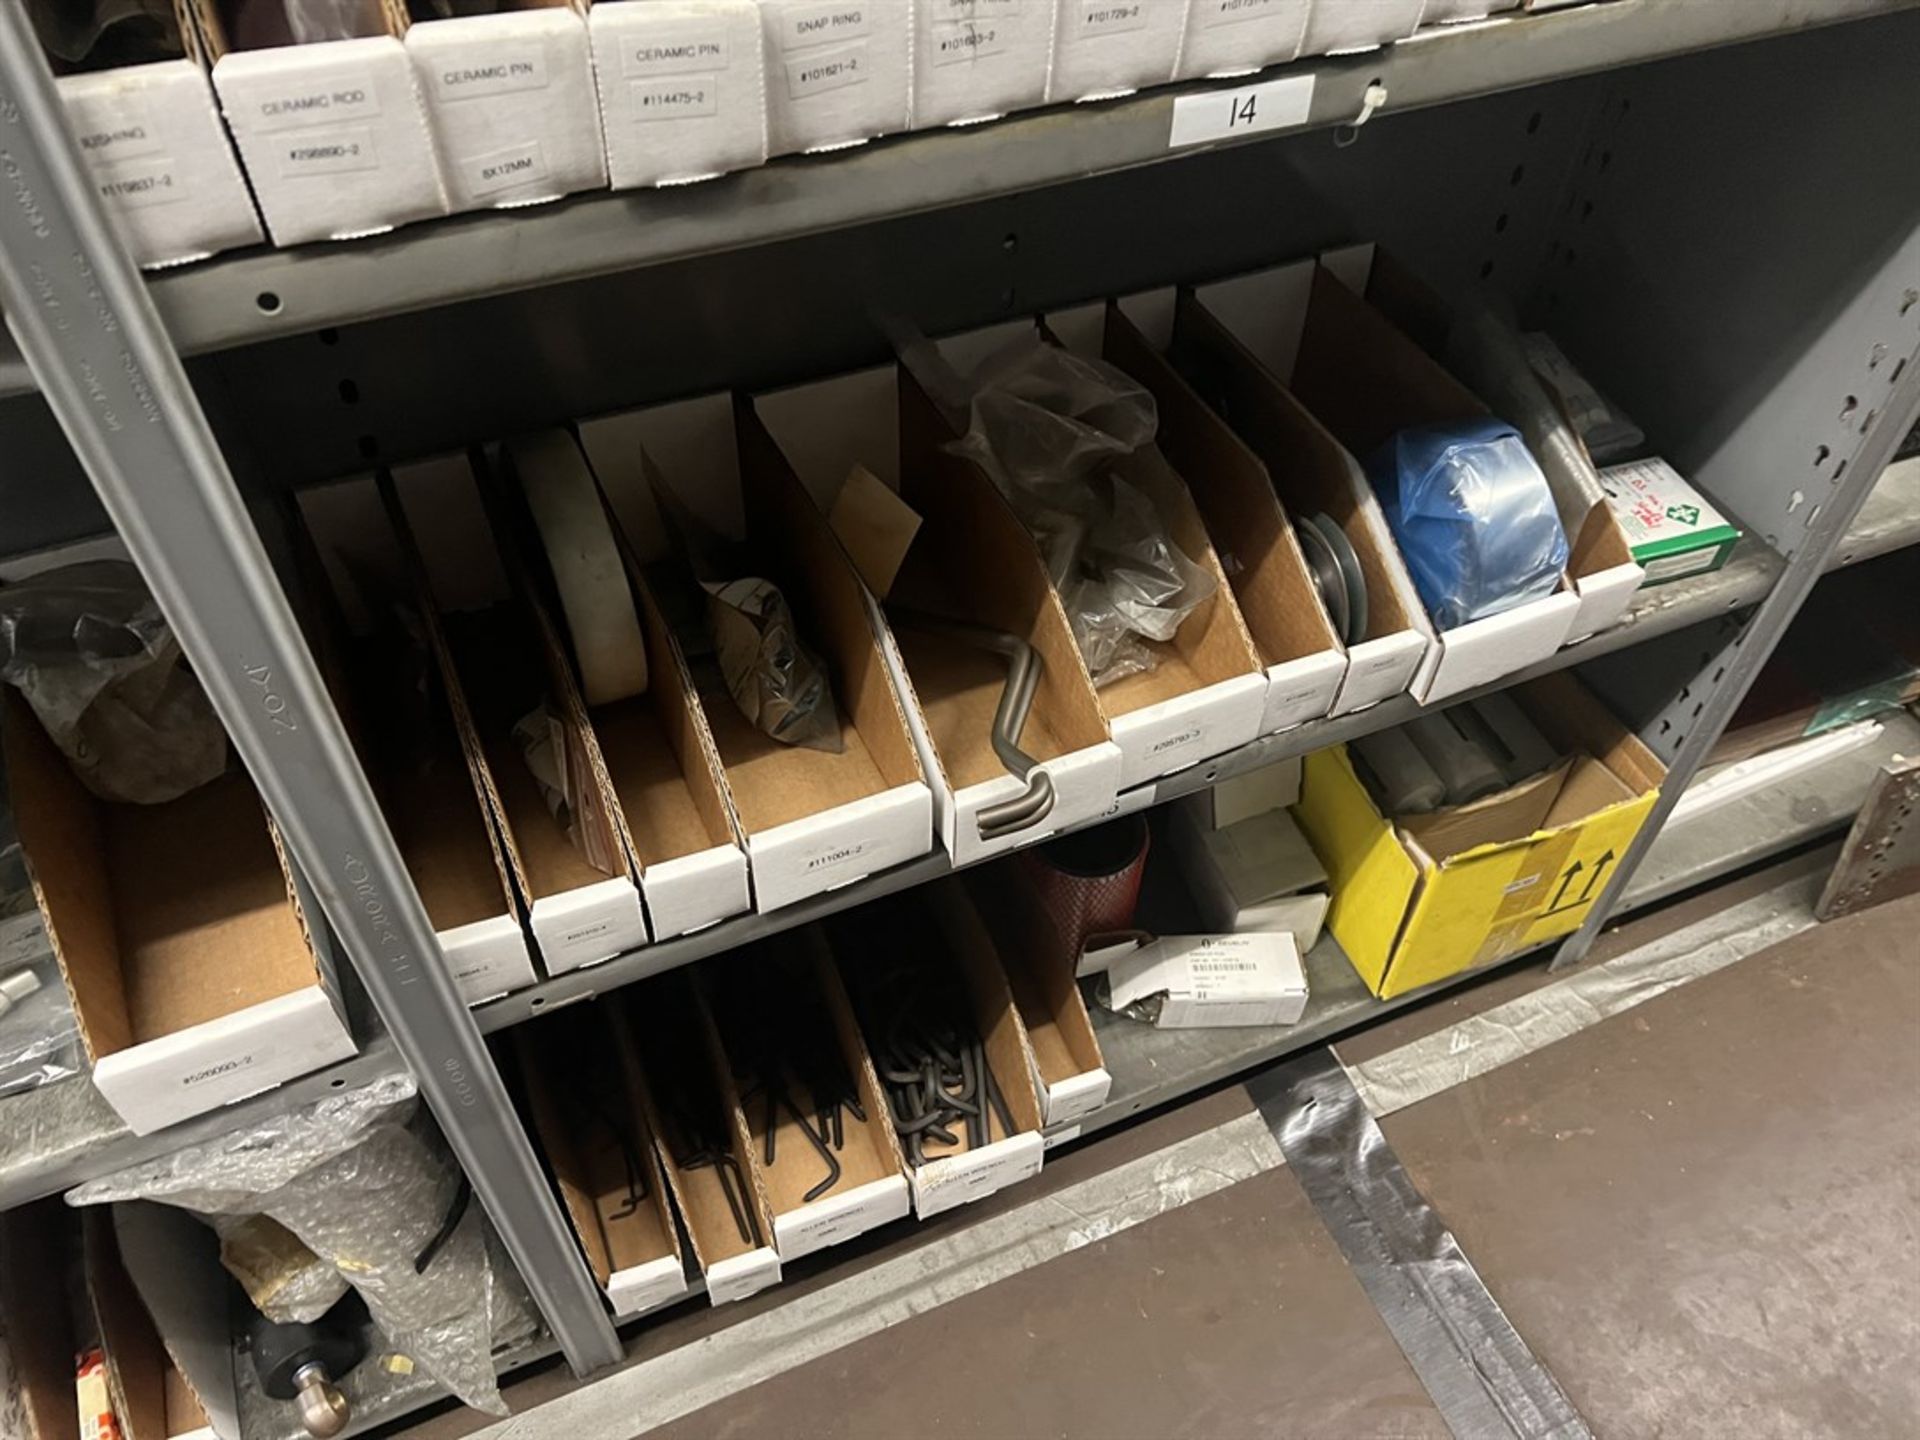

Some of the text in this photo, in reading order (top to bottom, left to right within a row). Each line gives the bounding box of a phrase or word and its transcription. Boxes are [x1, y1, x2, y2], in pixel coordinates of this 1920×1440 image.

[796, 11, 862, 34] SNAP RING
[636, 42, 720, 62] CERAMIC PIN
[444, 63, 534, 85] CERAMIC PIN
[261, 89, 365, 116] CERAMIC ROD
[643, 91, 705, 106] #114475-2
